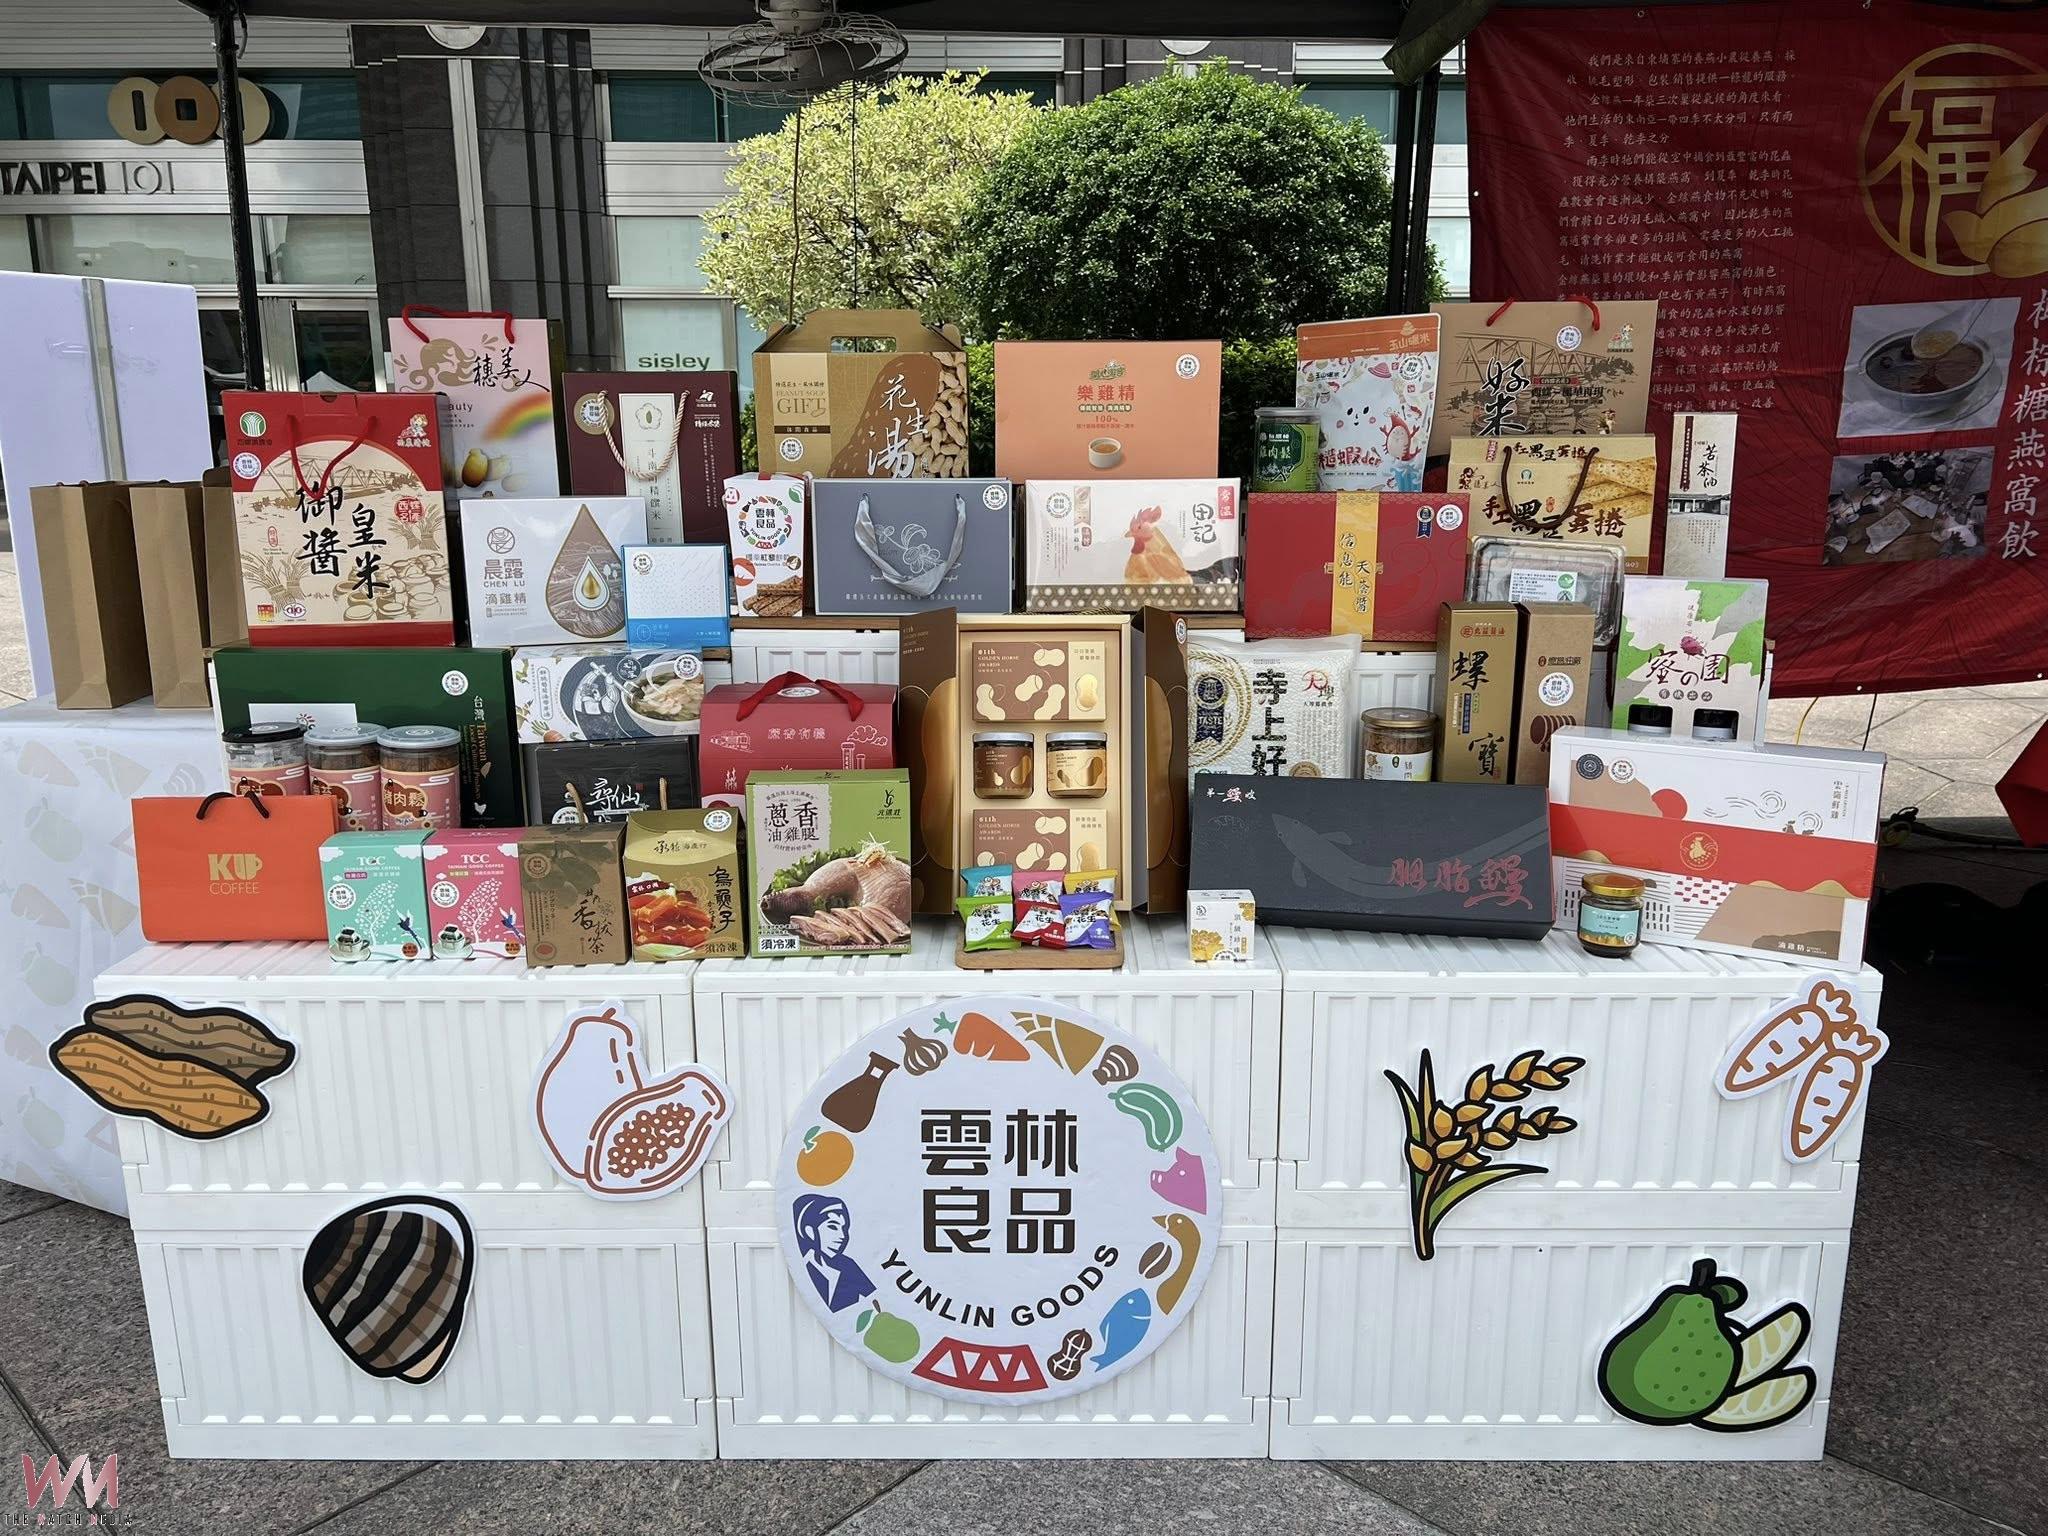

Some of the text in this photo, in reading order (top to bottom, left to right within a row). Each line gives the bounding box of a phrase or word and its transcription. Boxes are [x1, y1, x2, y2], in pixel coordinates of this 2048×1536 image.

[0, 162, 106, 195] TAIPEI
[638, 353, 711, 371] sisley
[1077, 384, 1136, 401] 樂雞精
[776, 397, 828, 415] GIFT
[483, 558, 525, 580] 晨露
[483, 580, 526, 588] CHEN LU
[1198, 716, 1224, 726] TASTE
[476, 721, 488, 762] Taiwan
[766, 801, 819, 828] 蔥香
[768, 827, 820, 844] 油雞腿
[356, 855, 387, 867] TCC
[460, 854, 490, 864] TCC
[209, 882, 260, 895] COFFEE
[760, 938, 797, 950] 須冷凍
[920, 1108, 1079, 1177] 雲林
[922, 1186, 1076, 1254] 良品
[881, 1244, 1119, 1328] YUNLIN GOODS
